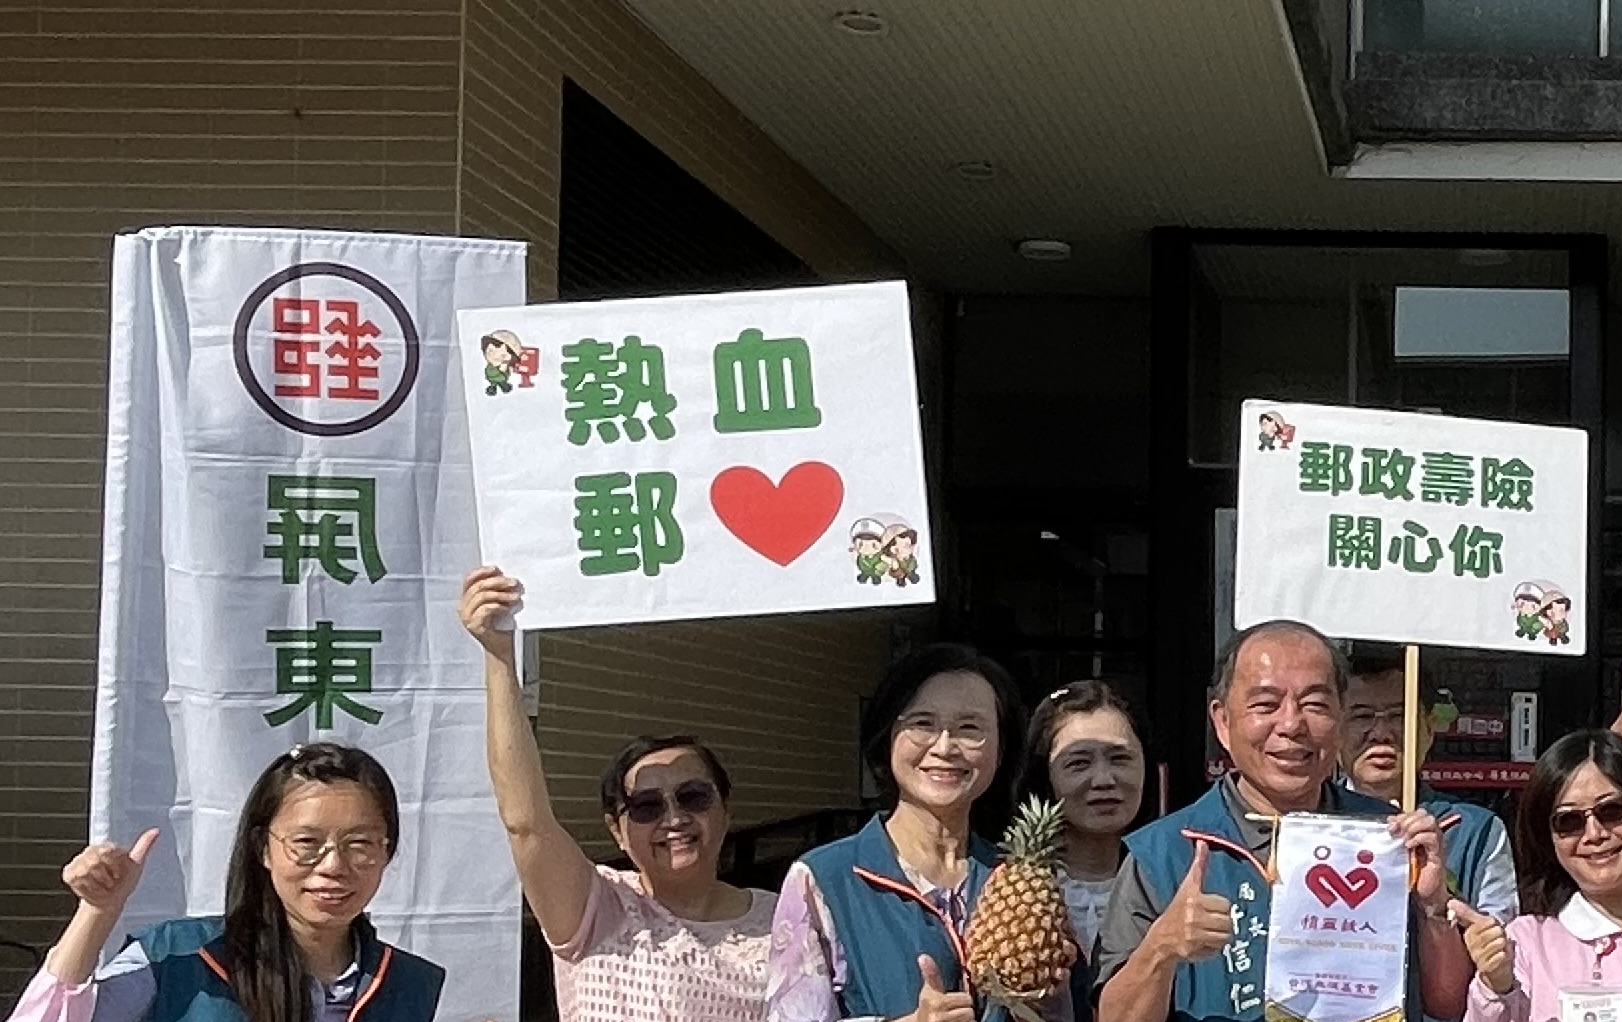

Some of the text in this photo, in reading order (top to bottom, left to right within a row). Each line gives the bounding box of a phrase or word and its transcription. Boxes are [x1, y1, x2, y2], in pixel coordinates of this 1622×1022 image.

[561, 328, 821, 445] 熱血
[1299, 441, 1534, 512] 郵政壽險
[574, 471, 684, 576] 郵
[1328, 513, 1503, 578] 關心你
